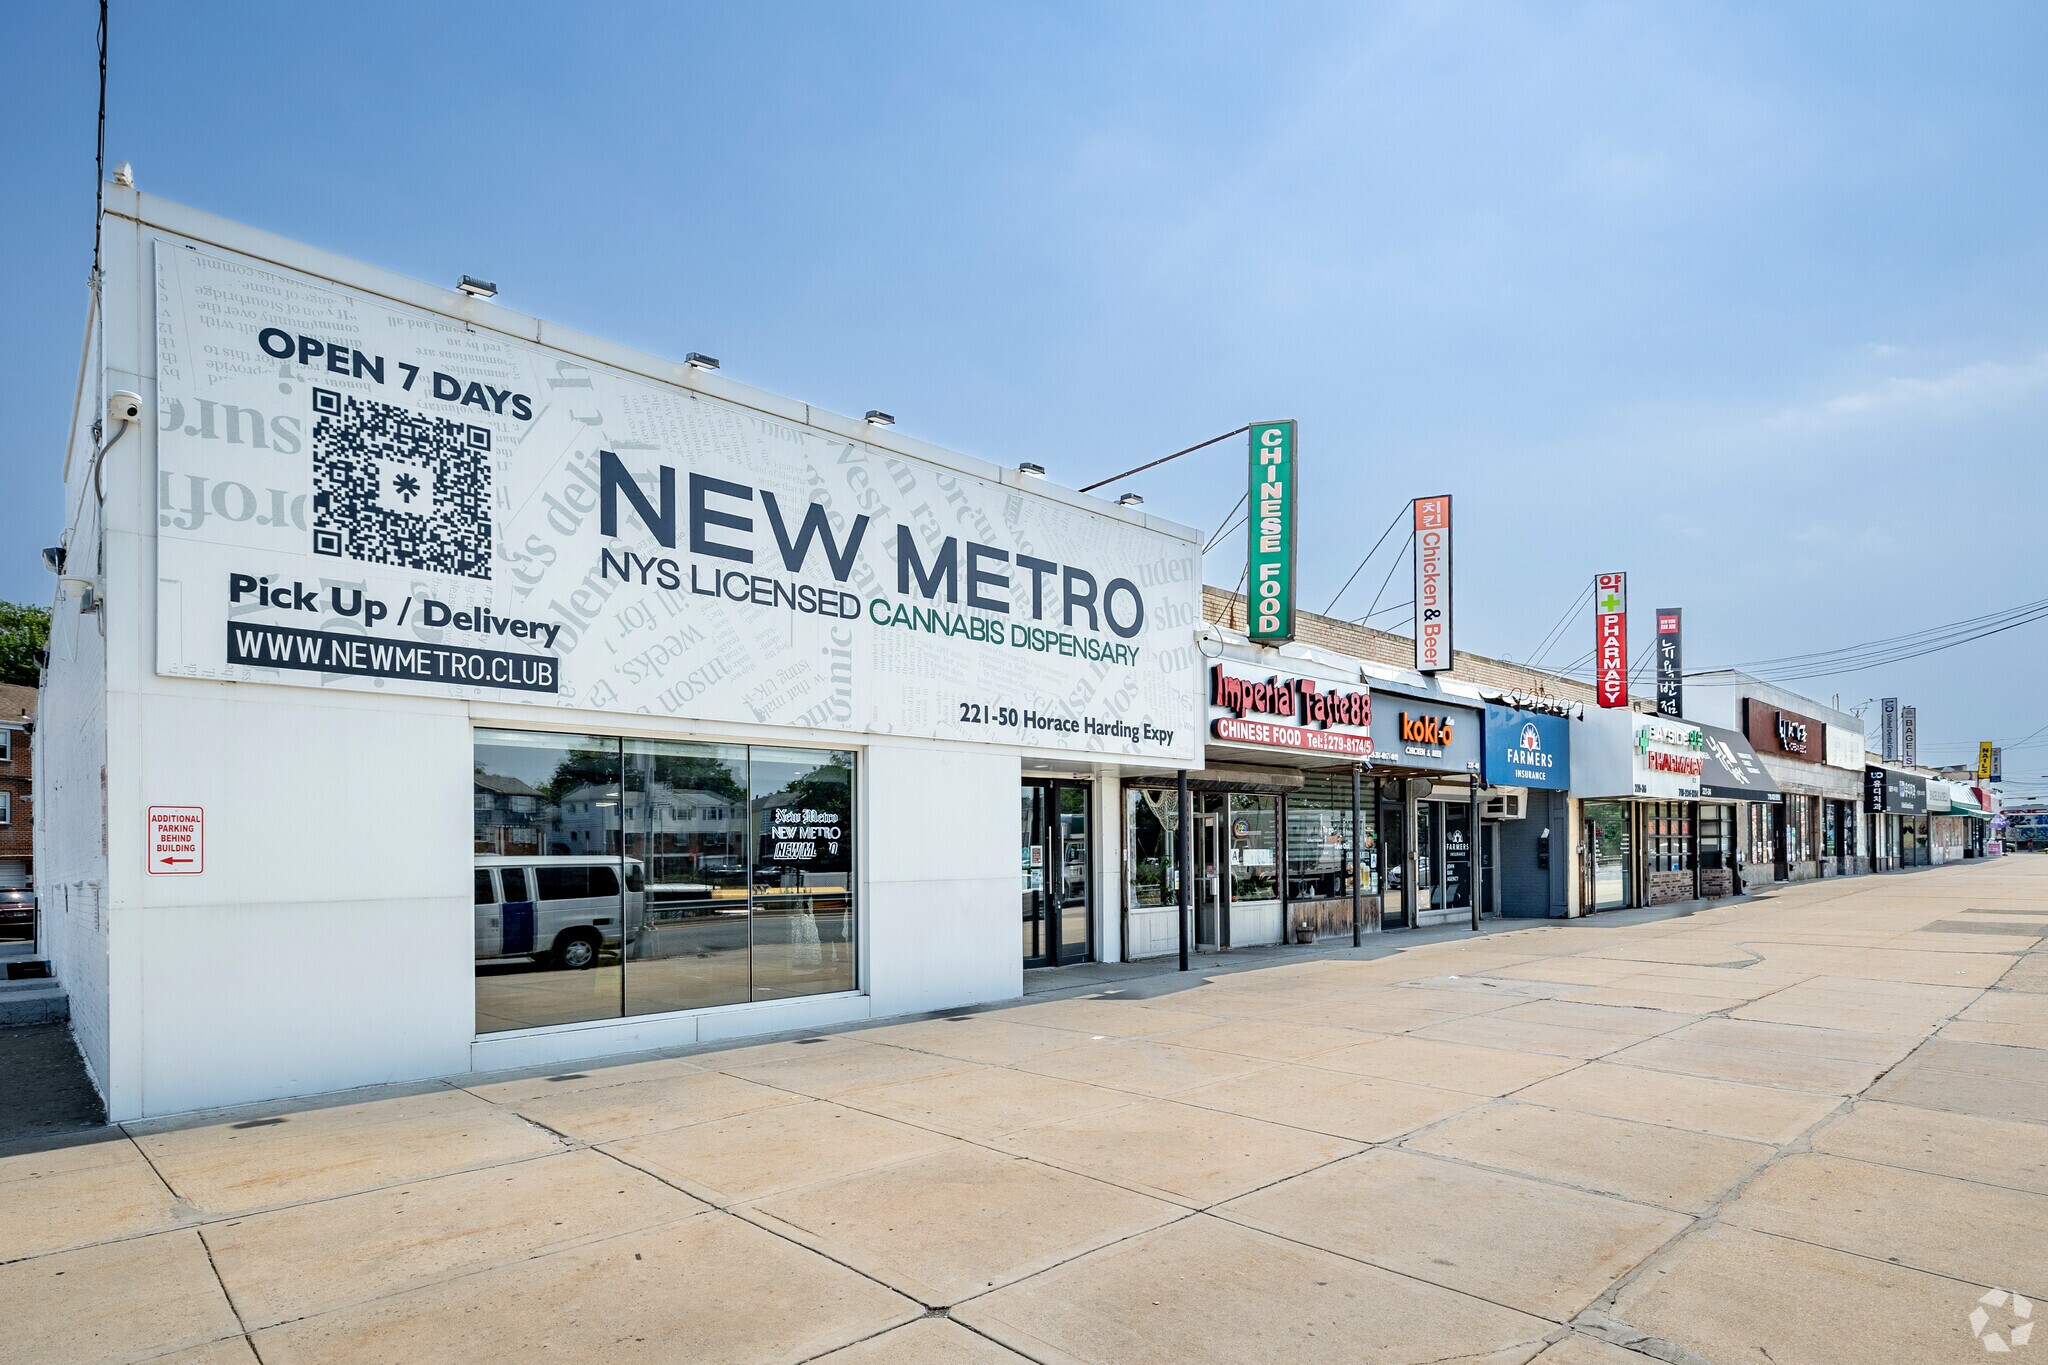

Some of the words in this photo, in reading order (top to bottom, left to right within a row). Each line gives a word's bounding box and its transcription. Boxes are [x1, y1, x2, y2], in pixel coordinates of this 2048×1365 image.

[258, 328, 384, 384] OPEN
[397, 362, 420, 392] 7
[433, 371, 533, 421] DAYS
[1259, 428, 1283, 554] CHINESE
[1423, 500, 1441, 529] 치킨
[600, 449, 870, 583] NEW
[897, 523, 1145, 639] METRO
[1423, 532, 1441, 606] Chicken
[229, 572, 319, 614] Pick
[331, 586, 387, 627] Up
[423, 600, 561, 649] Delivery
[601, 546, 680, 590] NYS
[692, 565, 861, 621] LICENSED
[868, 597, 1005, 646] CANNABIS
[1011, 623, 1140, 668] DISPENSARY
[1258, 563, 1282, 634] FOOD
[1423, 608, 1441, 622] &
[235, 629, 554, 687] WWW.NEWMETRO.CLUB
[1424, 624, 1441, 667] Beer
[1603, 615, 1621, 703] PHARMACY
[1211, 663, 1295, 719] Imperial
[959, 701, 1019, 730] 221-50
[1023, 709, 1080, 733] Horace
[1084, 716, 1140, 744] Harding
[1144, 723, 1174, 747] Expy
[1220, 719, 1270, 743] CHINESE
[1273, 727, 1301, 746] FOOD
[1307, 732, 1323, 749] Tel:
[1405, 746, 1426, 757] CHICKEN
[1905, 719, 1913, 765] BAGELS
[1507, 748, 1553, 768] FARMERS
[1648, 750, 1704, 776] PHARMACY
[1981, 747, 1989, 774] NAILS
[1515, 769, 1546, 781] INSURANCE
[152, 814, 201, 823] ADDITIONAL
[158, 824, 194, 832] PARKING
[775, 808, 801, 824] New
[802, 808, 839, 824] Metro
[156, 844, 195, 852] BUILDING
[161, 834, 192, 842] BEHIND
[771, 826, 797, 840] NEW
[799, 826, 841, 840] METRO
